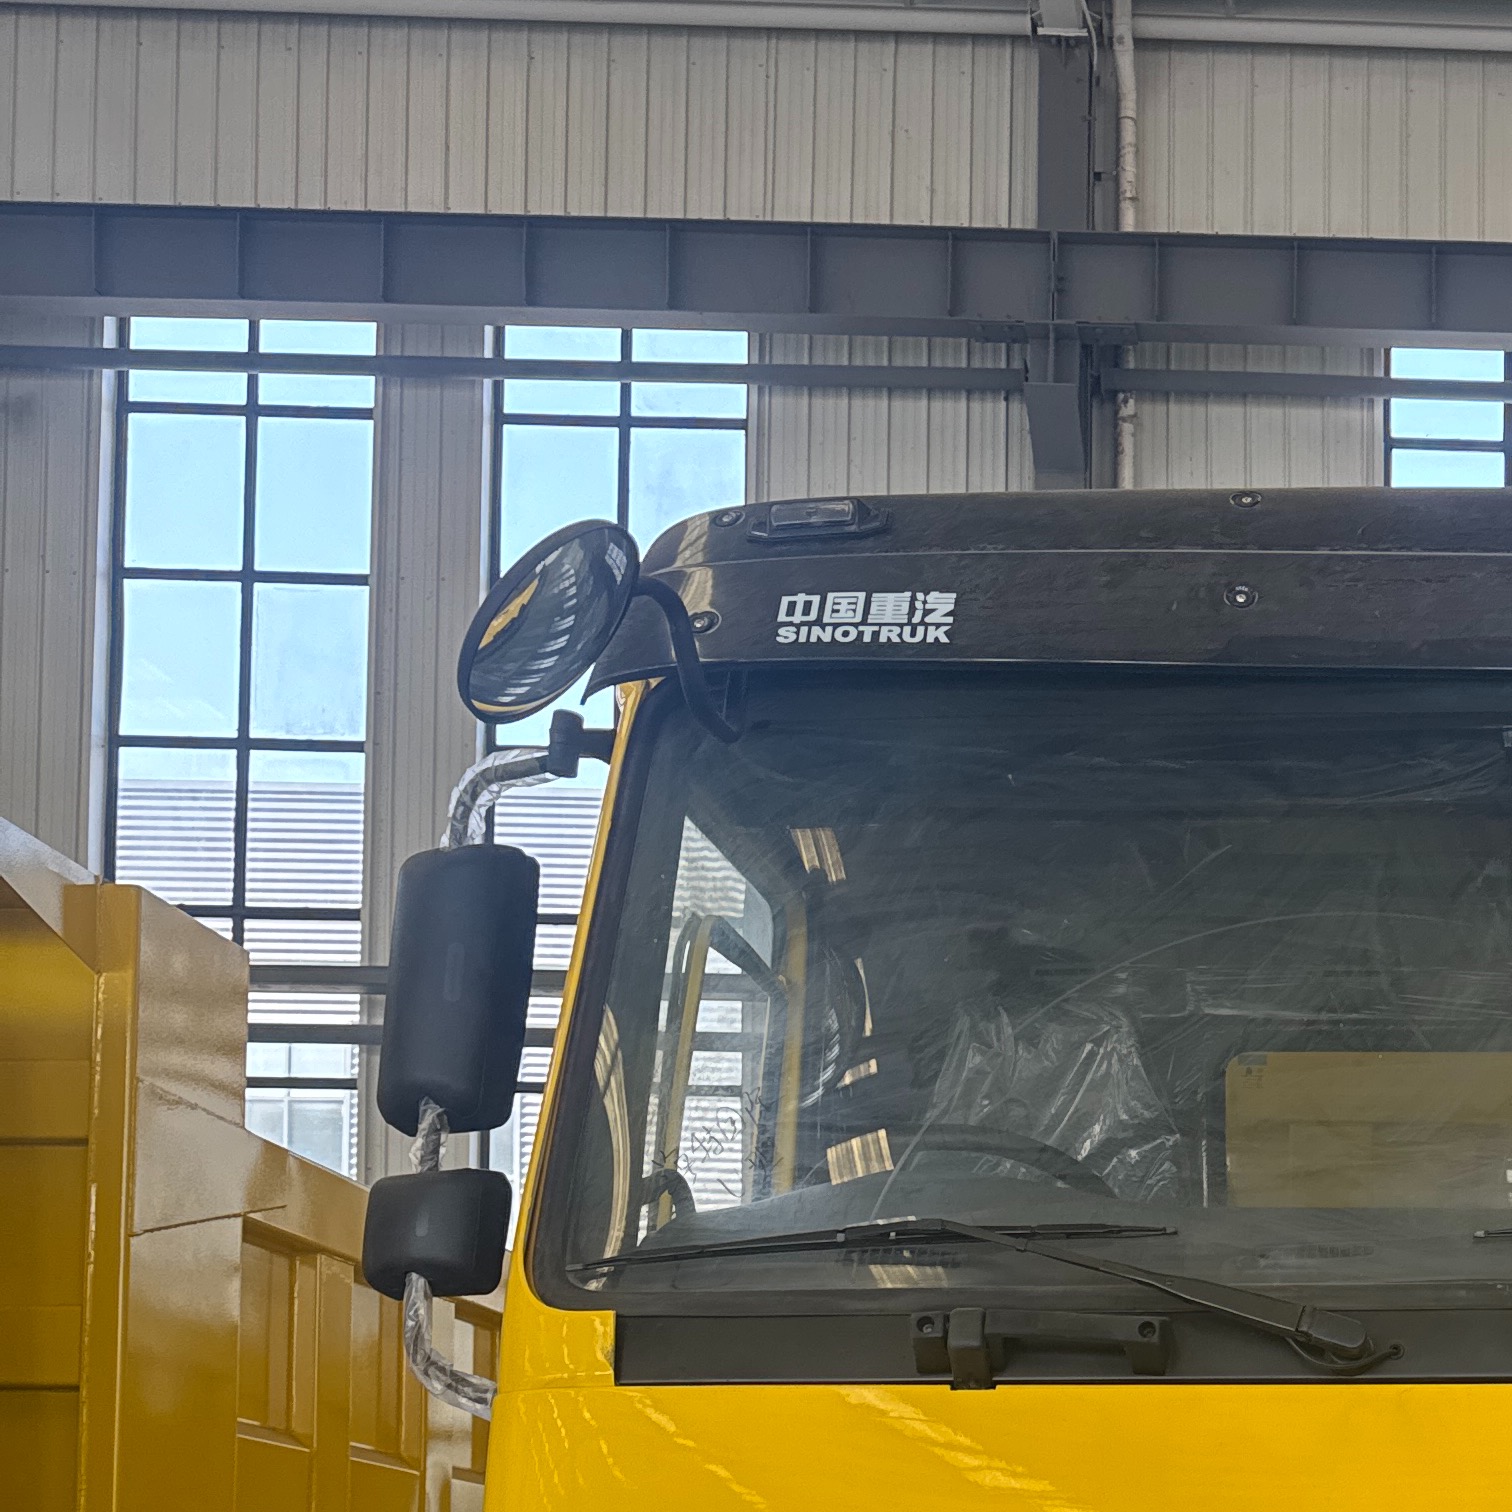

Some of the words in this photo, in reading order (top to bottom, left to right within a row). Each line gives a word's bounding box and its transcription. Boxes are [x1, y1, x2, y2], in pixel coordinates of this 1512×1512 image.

[776, 591, 957, 624] 中国重汽
[776, 625, 952, 643] SINOTRUK
